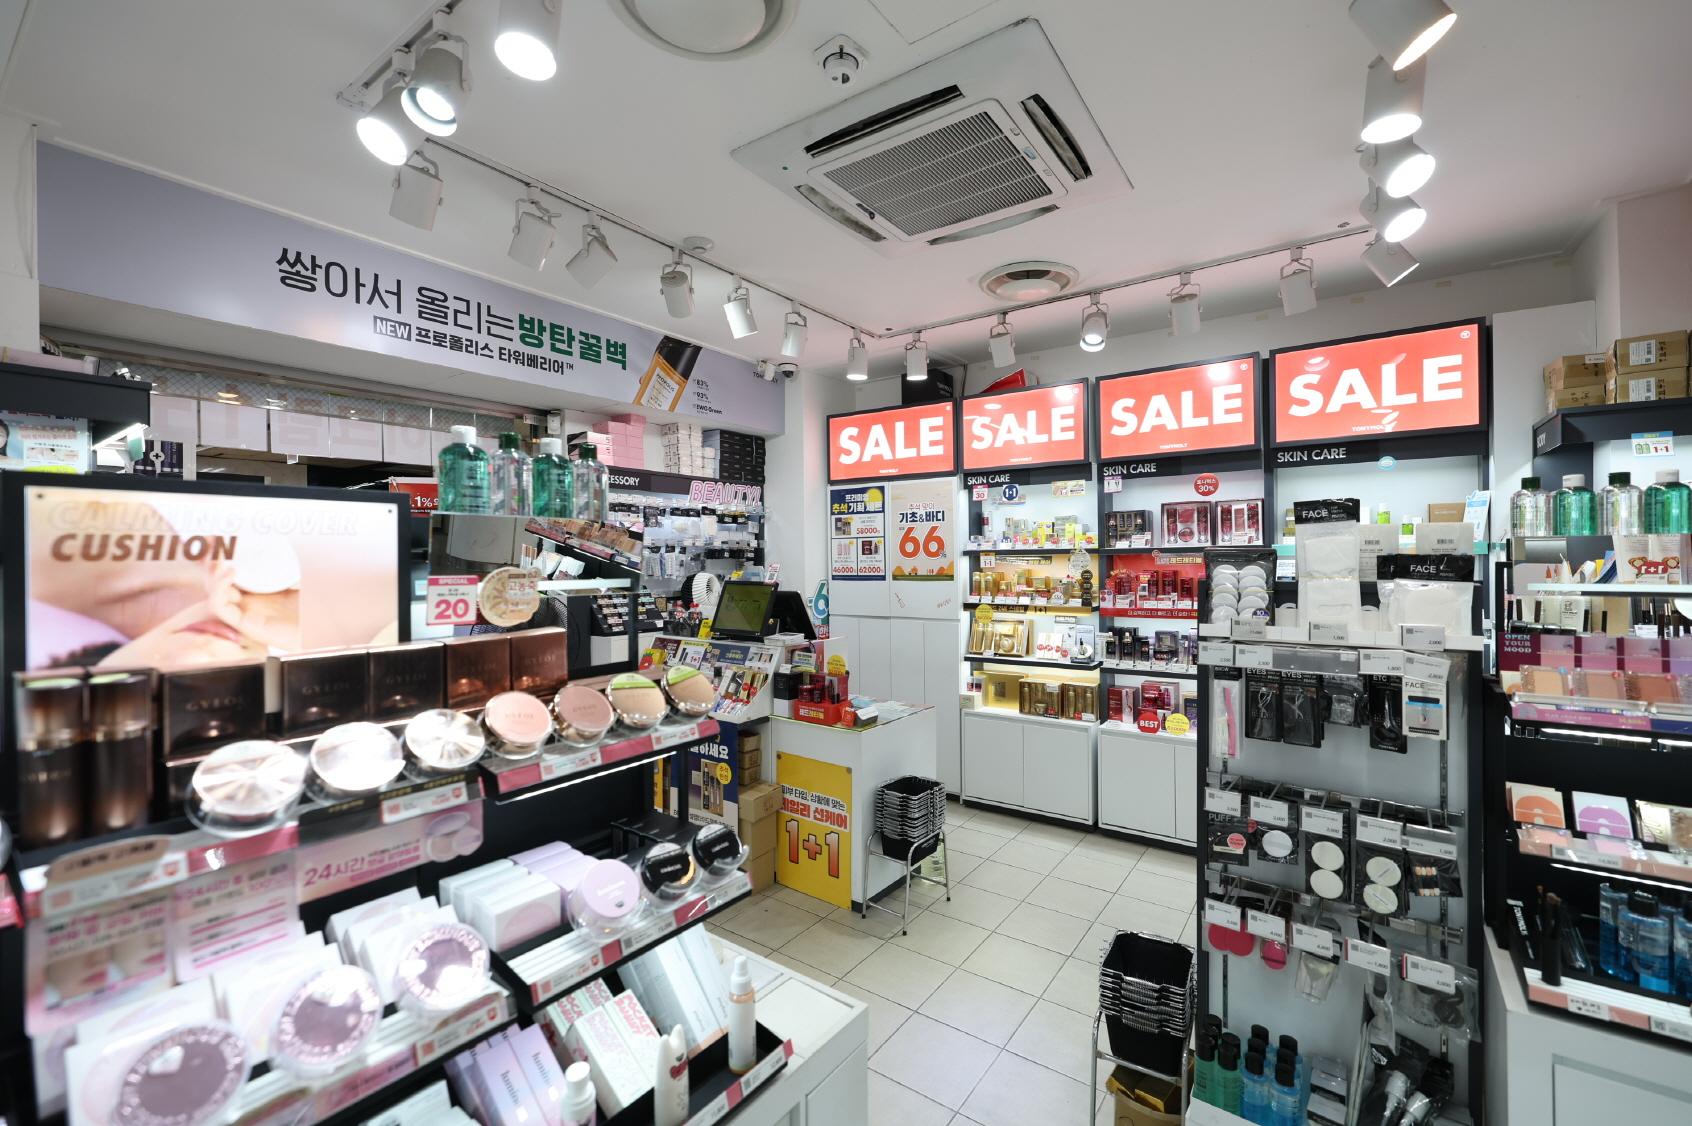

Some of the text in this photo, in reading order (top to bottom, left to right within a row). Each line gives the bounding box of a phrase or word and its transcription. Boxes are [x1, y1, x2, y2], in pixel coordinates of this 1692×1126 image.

[276, 247, 627, 371] 쌓아서 올리는 방탄꿀벽
[376, 318, 410, 340] NEW
[415, 326, 494, 359] 프로폴리스
[1288, 353, 1464, 418] SALE
[1110, 383, 1244, 437] SALE
[970, 405, 1076, 451] SALE
[1351, 423, 1395, 433] TONYMOL
[838, 415, 944, 465] SALE
[1277, 448, 1347, 463] SKIN CARE
[1652, 445, 1670, 453] 1+1
[1103, 463, 1157, 476] SKIN CARE
[967, 474, 1011, 485] SKIN CARE
[1004, 487, 1018, 498] 1+1
[832, 503, 848, 513] 추석
[849, 501, 865, 512] 기획
[908, 503, 921, 511] 추석
[1302, 508, 1329, 519] FACE
[899, 511, 945, 523] 기초&바디
[249, 512, 360, 537] COVER
[51, 532, 238, 562] CUSHION
[899, 526, 945, 558] 66
[1410, 564, 1437, 574] FACE
[434, 598, 470, 620] 20
[1246, 668, 1267, 676] EYES
[1281, 671, 1302, 679] EYES
[1139, 720, 1159, 729] BEST
[813, 806, 848, 830] 선케어
[1209, 813, 1232, 822] PUFF
[785, 818, 840, 879] 1+1
